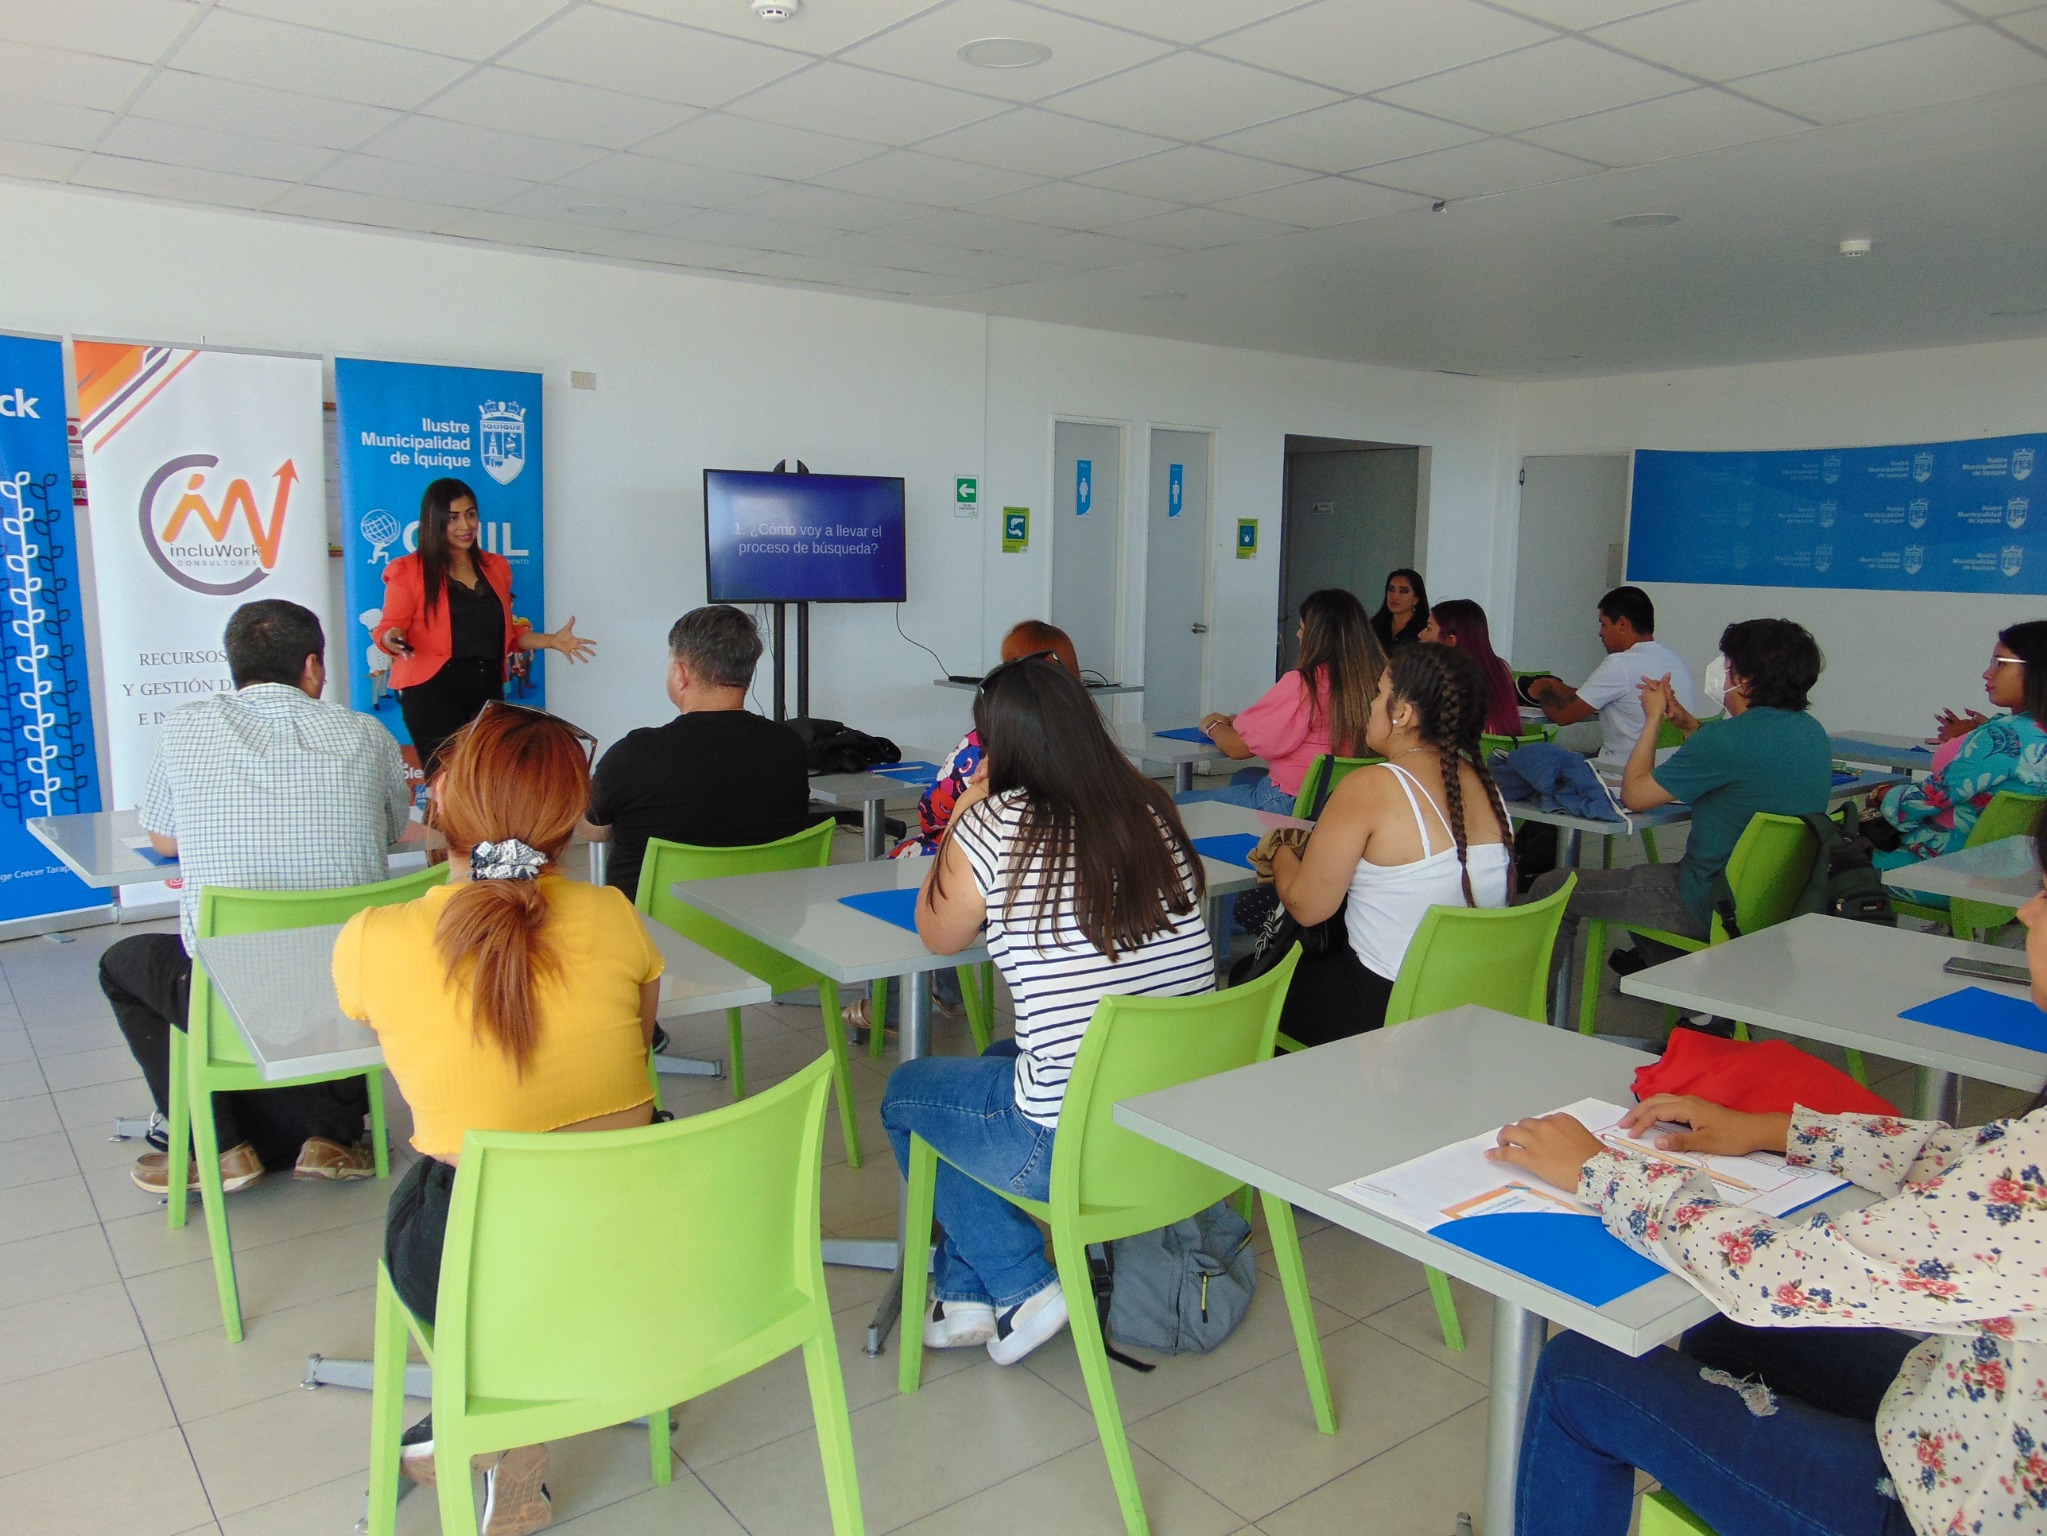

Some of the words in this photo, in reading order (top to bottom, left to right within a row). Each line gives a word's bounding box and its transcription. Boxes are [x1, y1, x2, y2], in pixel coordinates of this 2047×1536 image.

[422, 417, 471, 434] Ilustre
[482, 423, 522, 431] IQUIQUE
[361, 431, 471, 451] Municipalidad
[390, 451, 410, 465] de
[414, 451, 471, 469] Iquique
[733, 522, 745, 535] 1.
[750, 522, 796, 537] ¿Cómo
[800, 526, 821, 538] voy
[825, 527, 833, 536] a
[836, 524, 868, 537] llevar
[871, 525, 882, 537] el
[169, 542, 261, 557] incluWork
[738, 542, 790, 556] proceso
[793, 541, 808, 553] de
[812, 541, 878, 557] búsqueda?
[138, 650, 227, 666] RECURSOS
[122, 684, 134, 697] Y
[140, 678, 214, 696] GESTIÓN
[219, 679, 237, 691] D
[138, 713, 148, 725] E
[14, 868, 45, 878] Crecer
